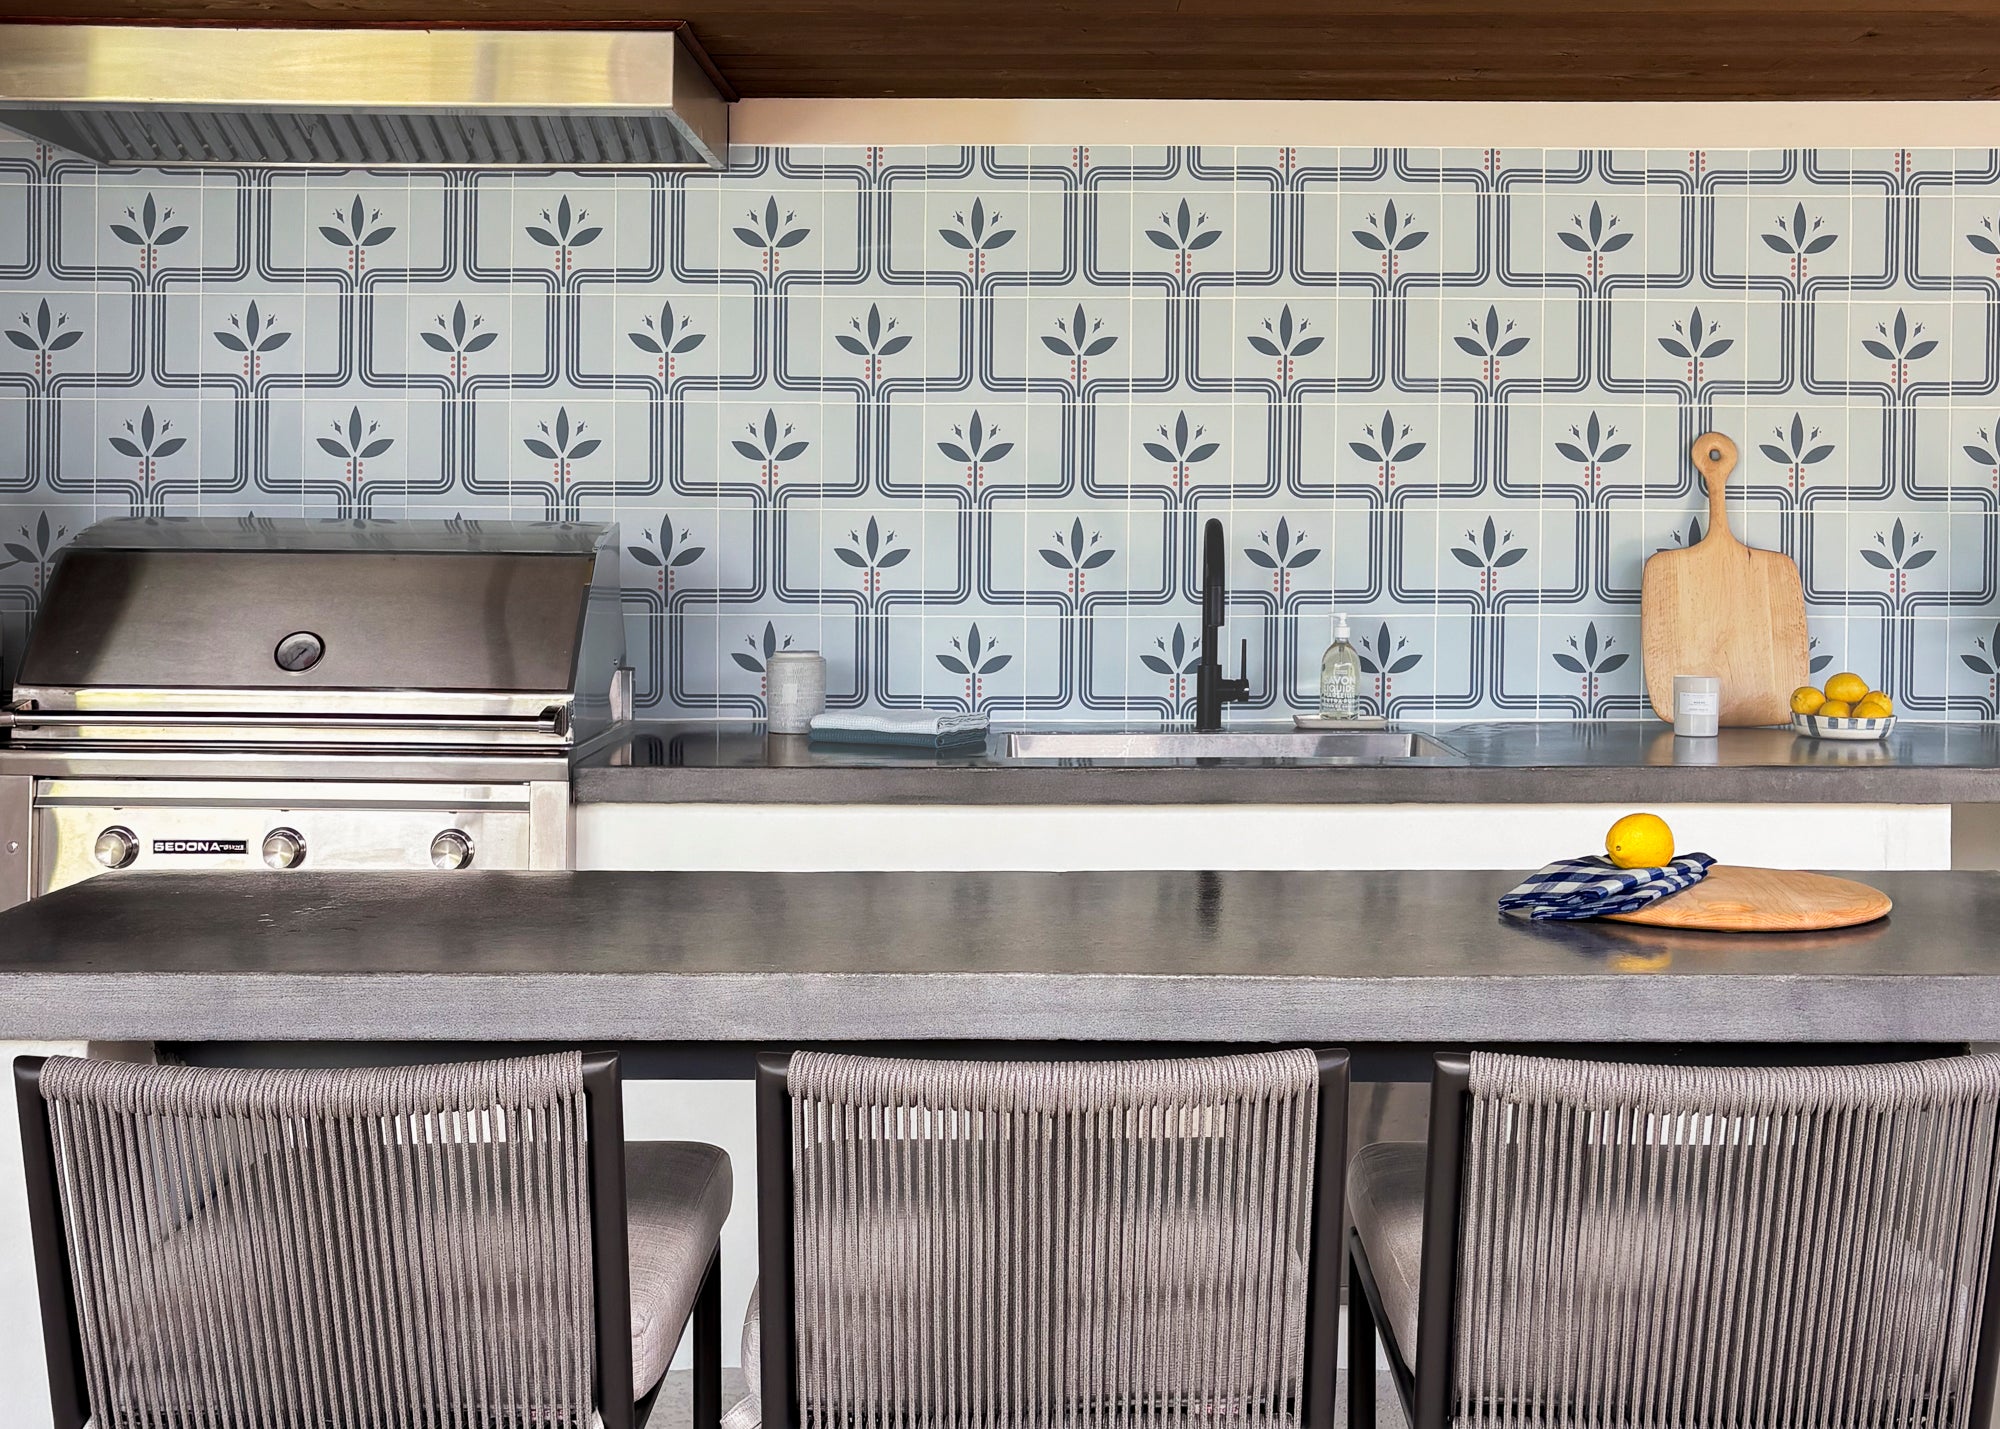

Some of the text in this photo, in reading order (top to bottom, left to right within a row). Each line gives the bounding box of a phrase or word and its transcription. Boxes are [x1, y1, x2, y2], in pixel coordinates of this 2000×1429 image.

[1324, 676, 1356, 685] SAVON
[1324, 684, 1356, 693] LIQUIDE
[154, 842, 221, 852] SEDONA
